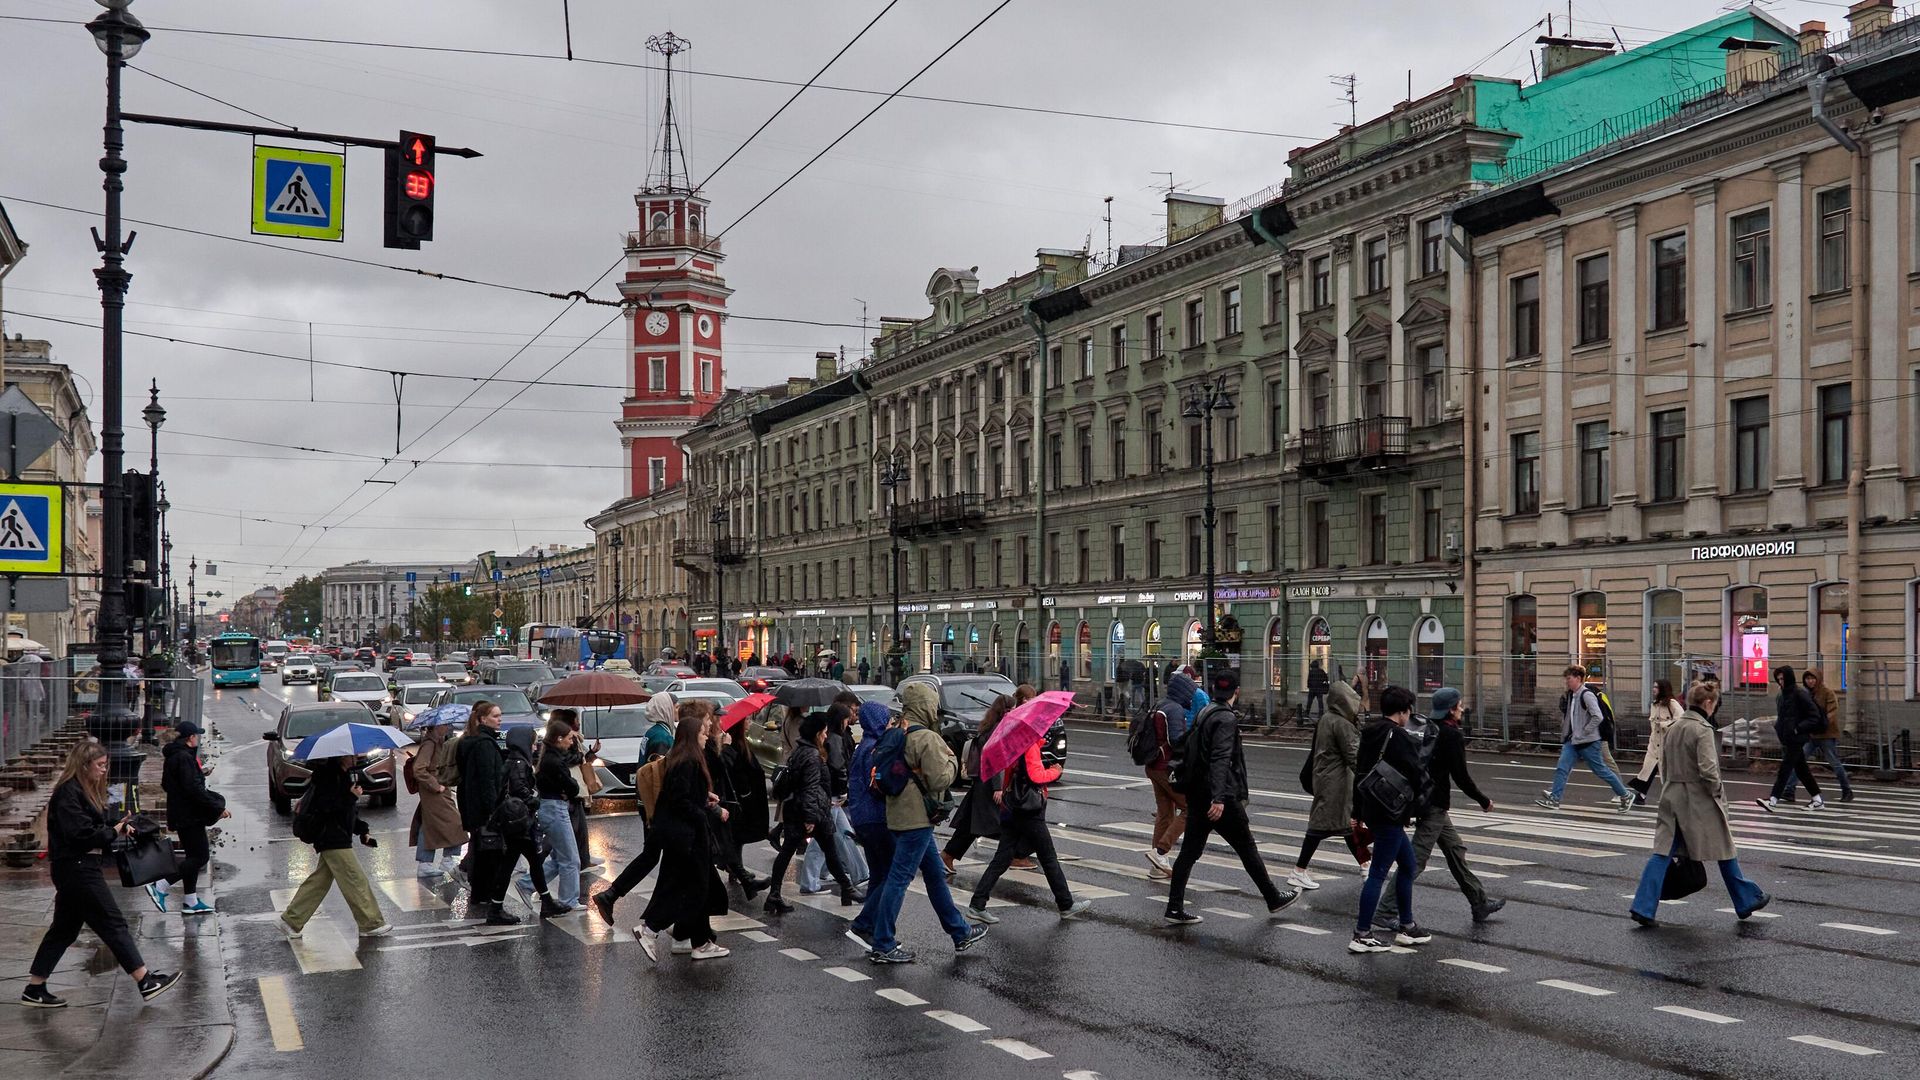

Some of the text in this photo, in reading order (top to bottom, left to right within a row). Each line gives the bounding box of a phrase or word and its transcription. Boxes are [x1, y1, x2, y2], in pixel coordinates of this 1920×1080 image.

[406, 174, 429, 198] 33
[1174, 591, 1203, 602] СУВЕНИРЫ
[1291, 586, 1330, 597] САЛОН ЧАСОВ
